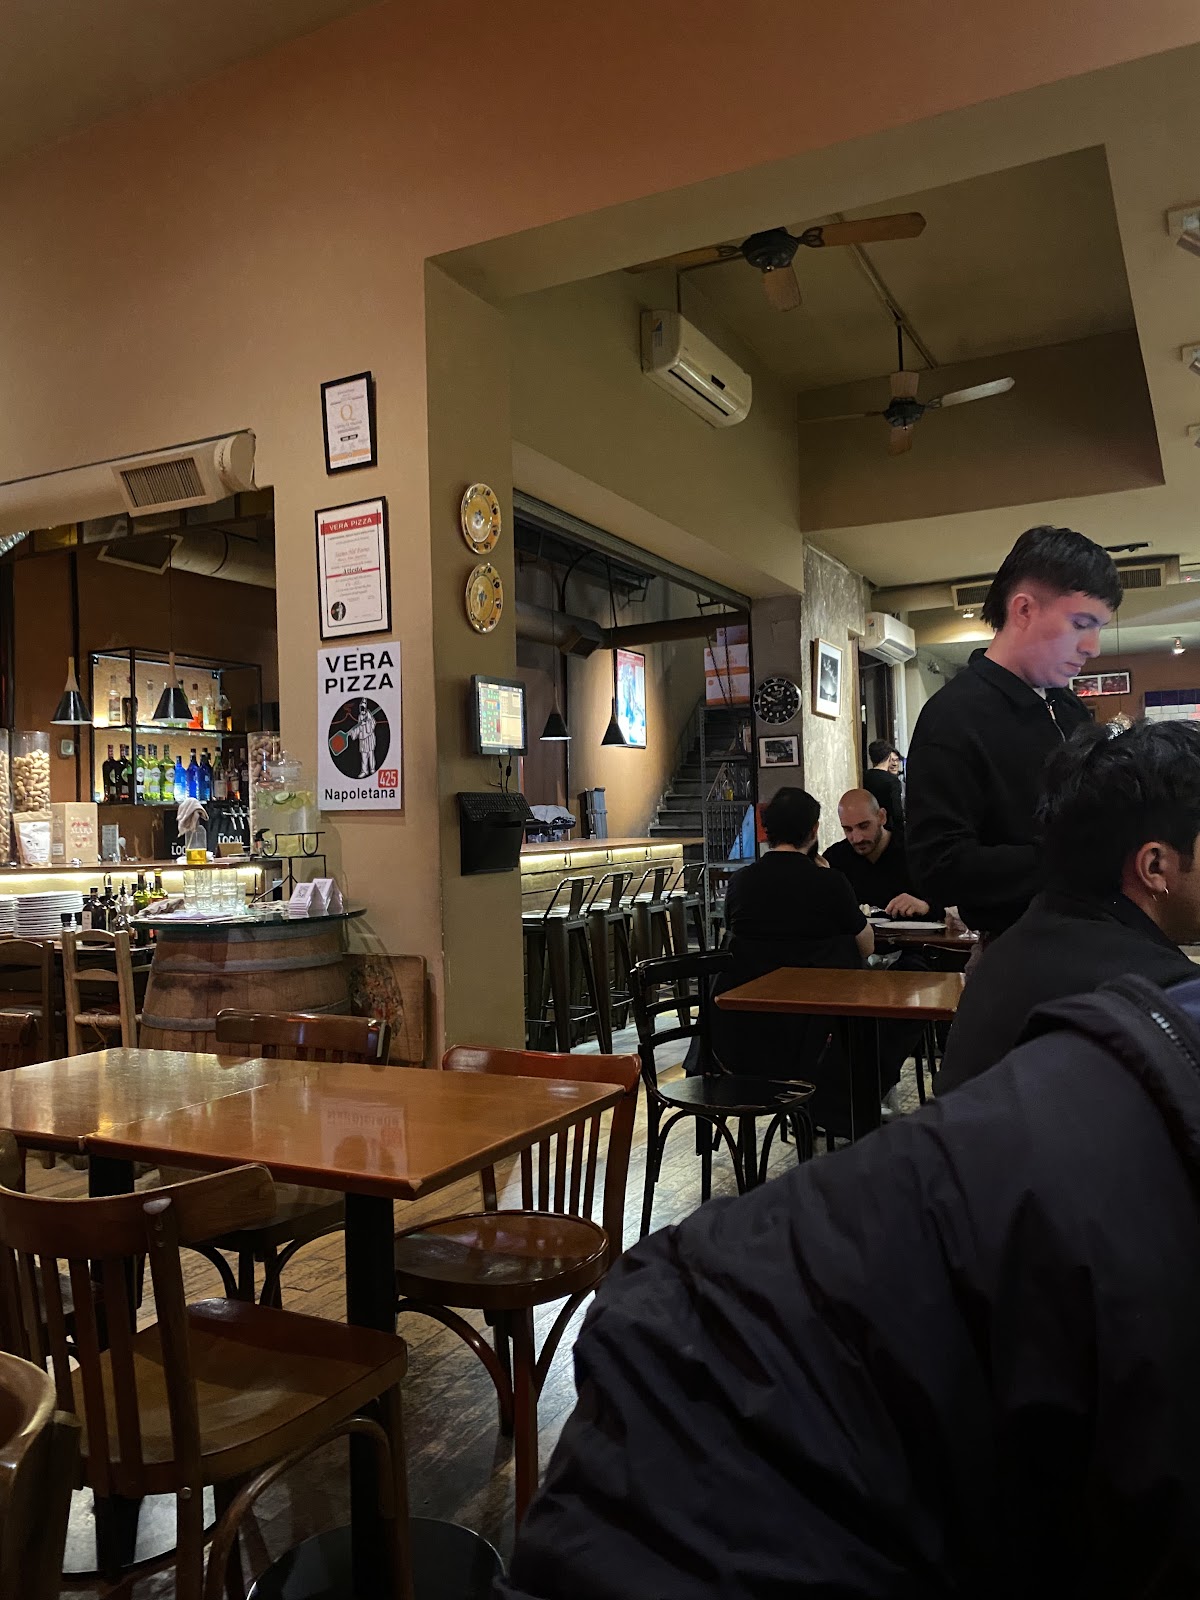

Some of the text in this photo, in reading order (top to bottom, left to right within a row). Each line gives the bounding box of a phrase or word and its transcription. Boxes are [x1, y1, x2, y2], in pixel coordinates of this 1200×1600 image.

[329, 517, 372, 531] VERA PIZZA
[325, 651, 394, 673] VERA
[325, 673, 394, 694] PIZZA
[379, 771, 397, 787] 425
[325, 787, 396, 802] Napoletana
